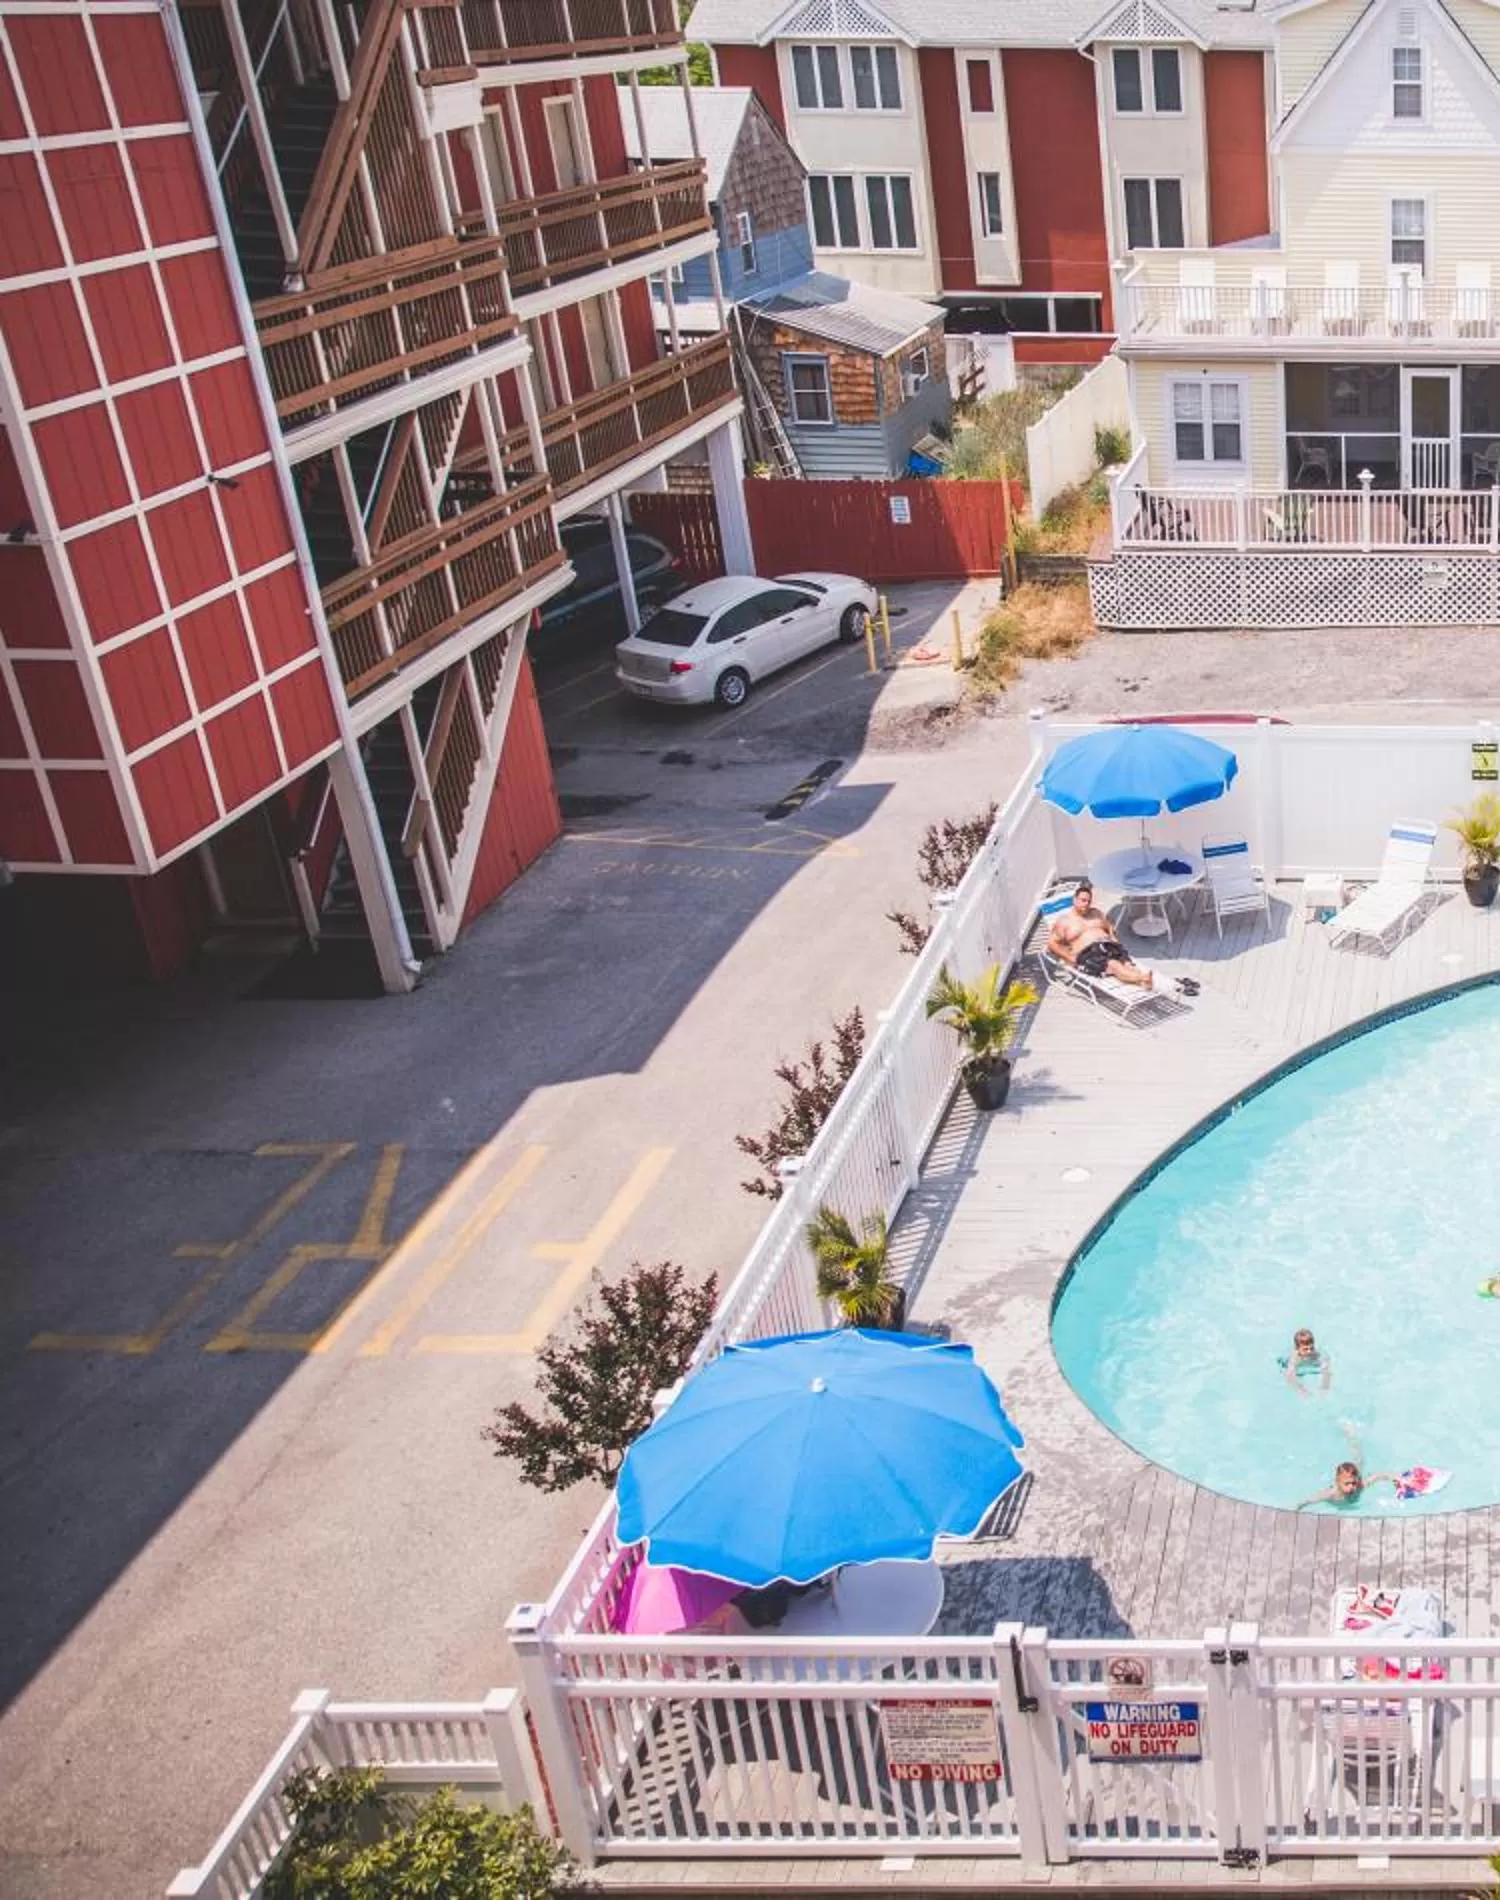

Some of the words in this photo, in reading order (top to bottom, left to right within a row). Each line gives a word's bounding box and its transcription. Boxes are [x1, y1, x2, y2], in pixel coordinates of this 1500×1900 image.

[26, 1141, 676, 1356] FIRE
[1103, 1703, 1181, 1721] WARNING
[1090, 1723, 1111, 1739] NO
[1117, 1722, 1197, 1739] LIFEGUARD
[1111, 1740, 1131, 1754] ON
[1140, 1740, 1178, 1754] DUTY
[894, 1764, 922, 1780] NO
[931, 1764, 997, 1781] DIVING
